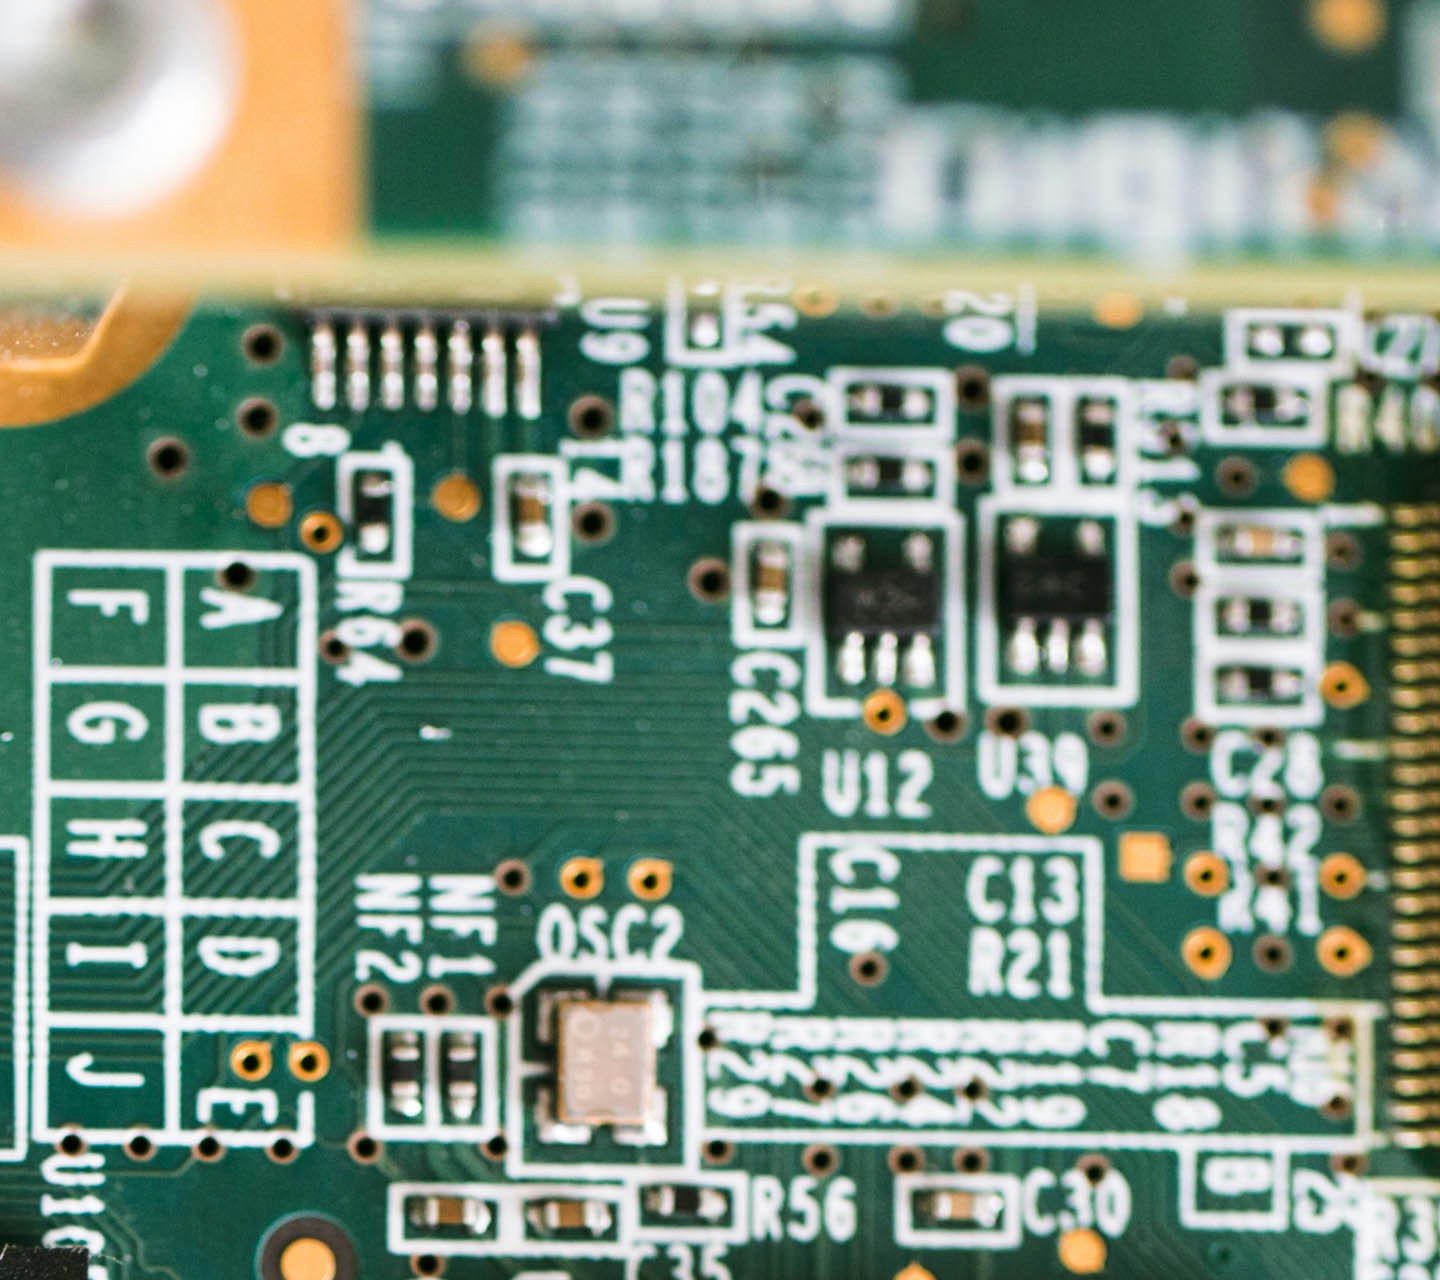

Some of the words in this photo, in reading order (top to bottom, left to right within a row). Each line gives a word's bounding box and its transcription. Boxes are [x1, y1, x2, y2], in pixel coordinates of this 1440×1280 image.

[618, 369, 761, 437] R104
[67, 589, 148, 624] F
[201, 587, 283, 629] A
[543, 574, 613, 683] C37
[729, 654, 800, 798] C265
[823, 750, 932, 817] U12
[427, 874, 497, 977] NF1
[830, 846, 900, 951] C16
[967, 858, 1079, 925] C13
[355, 874, 422, 983] NF2
[969, 929, 1074, 999] R21
[751, 1180, 856, 1241] R56
